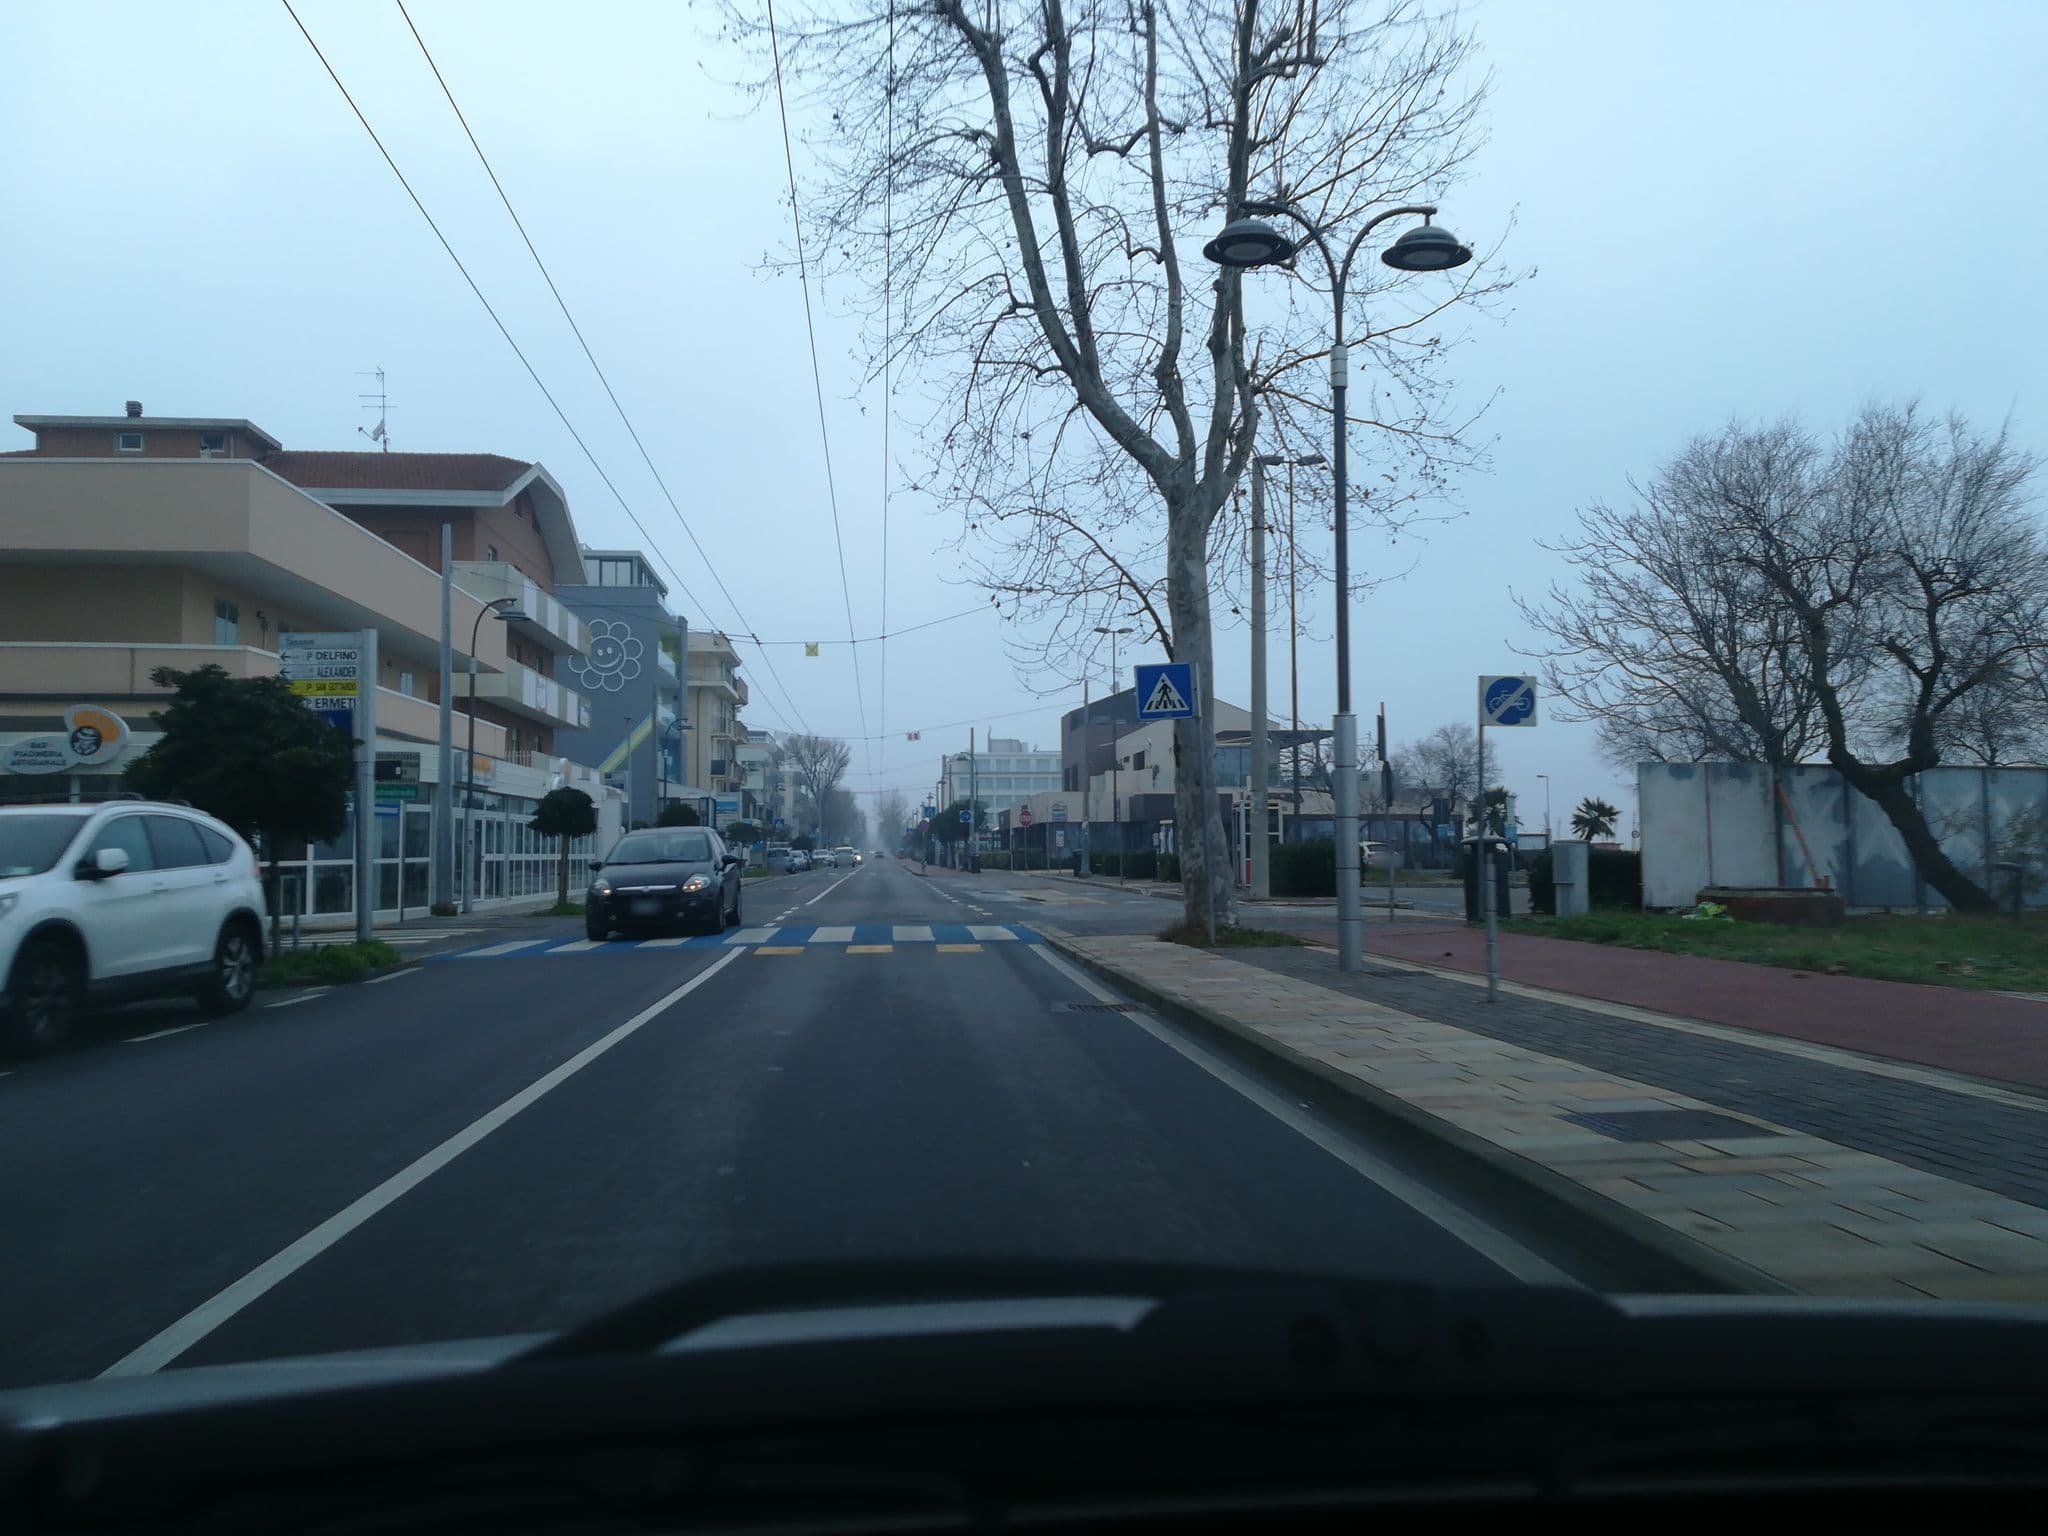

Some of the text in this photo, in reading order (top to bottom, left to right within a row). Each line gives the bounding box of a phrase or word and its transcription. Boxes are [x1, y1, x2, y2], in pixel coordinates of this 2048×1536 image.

[316, 651, 357, 661] DELFINO
[317, 666, 357, 678] ALEXANDER
[315, 698, 357, 709] ERMETI
